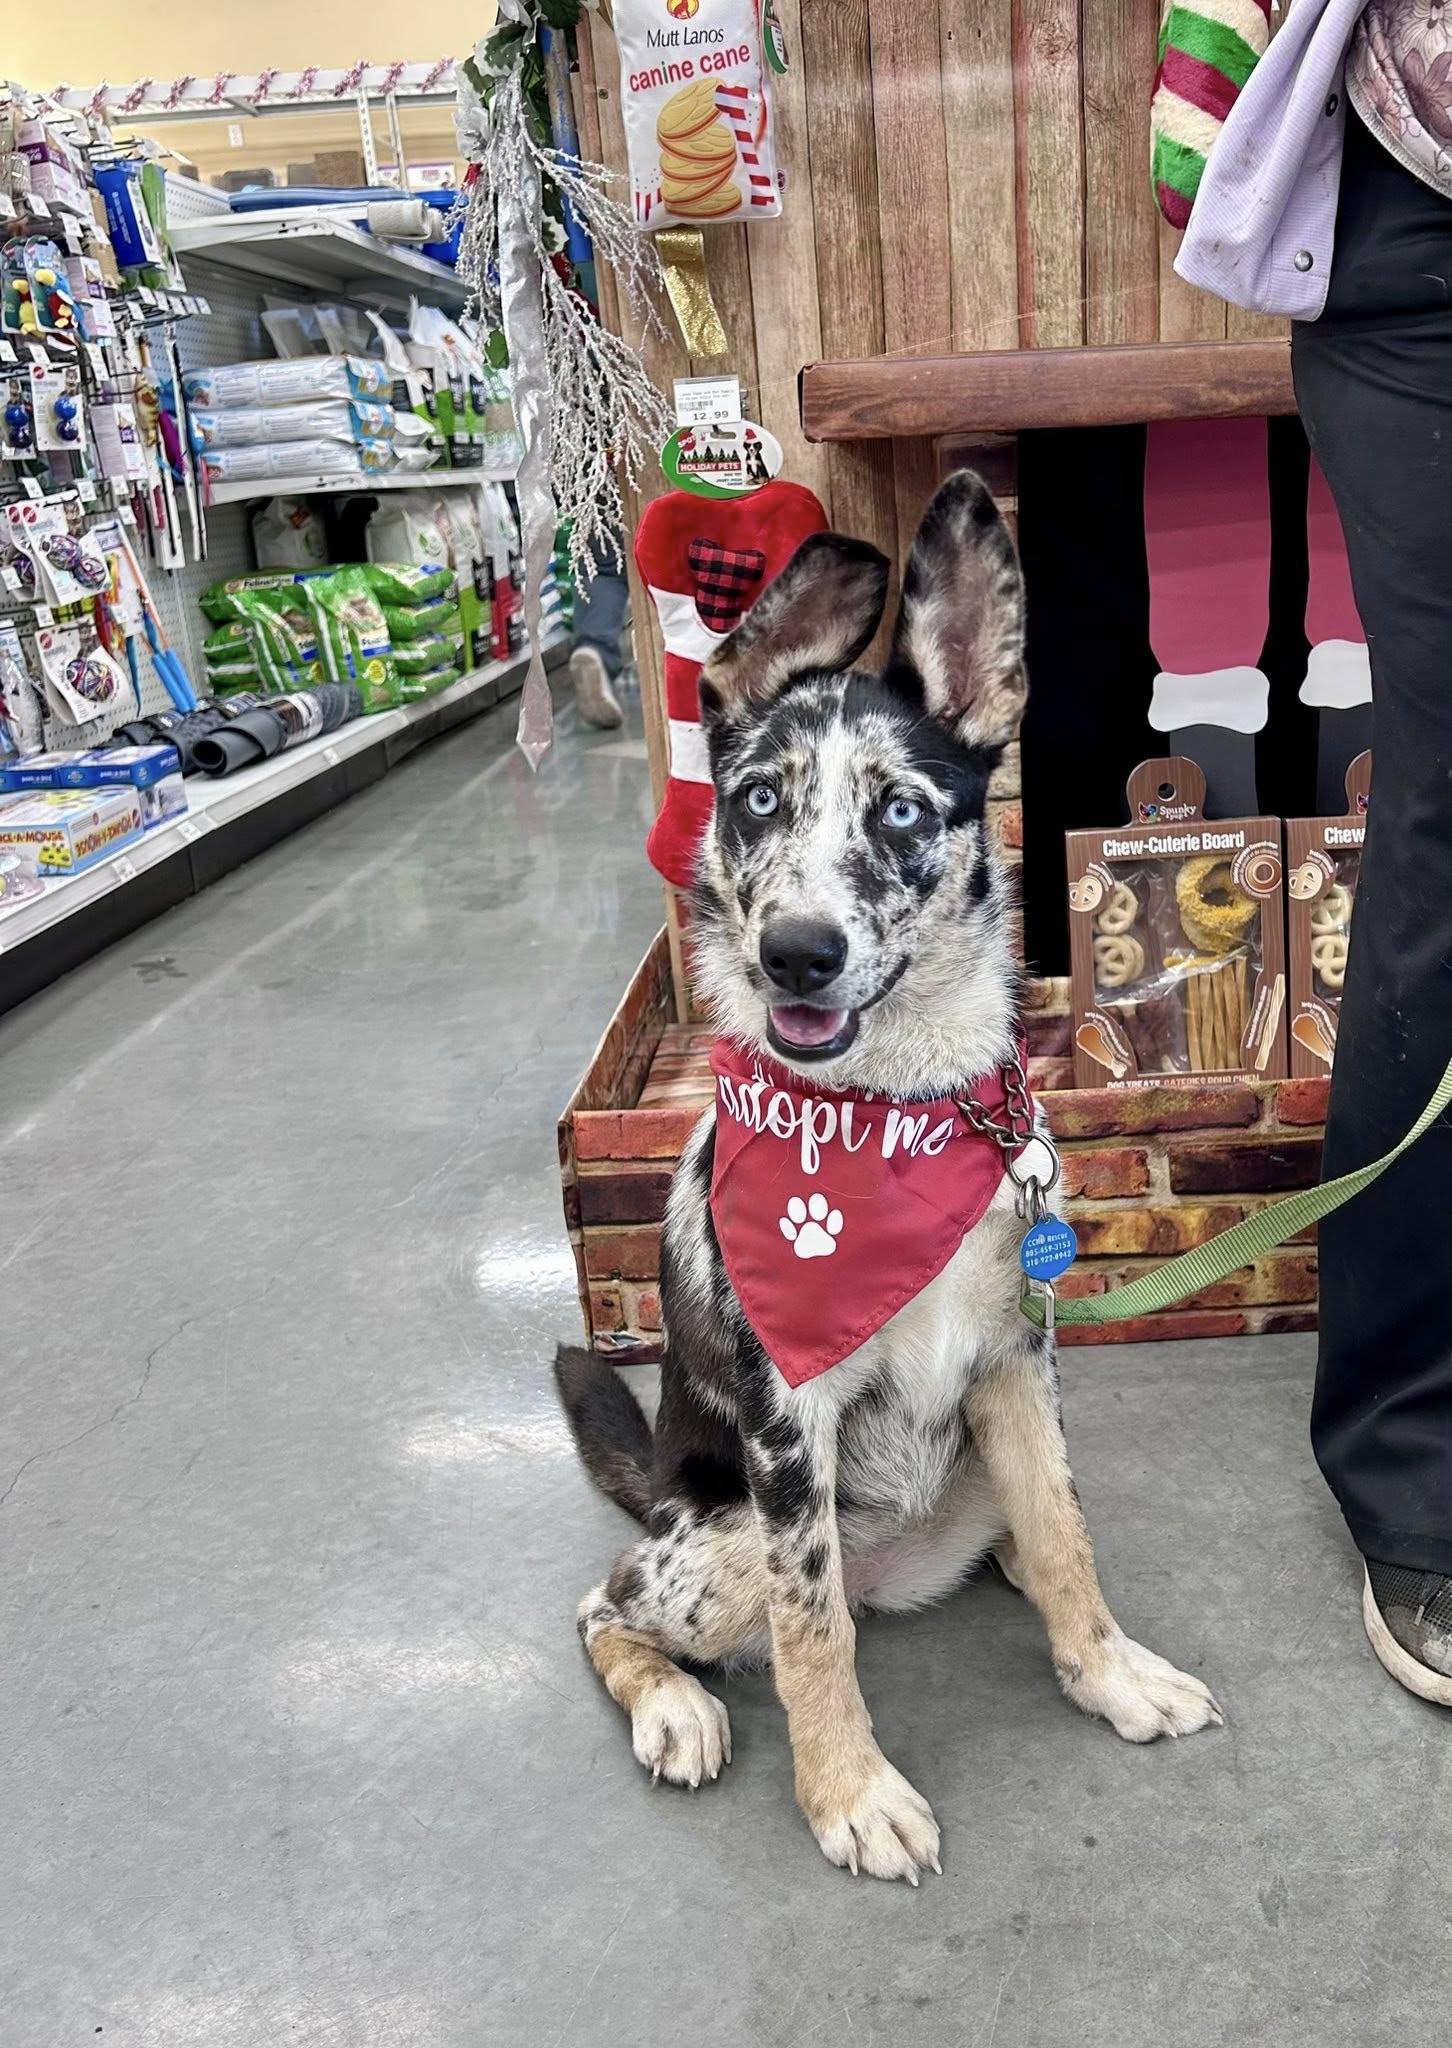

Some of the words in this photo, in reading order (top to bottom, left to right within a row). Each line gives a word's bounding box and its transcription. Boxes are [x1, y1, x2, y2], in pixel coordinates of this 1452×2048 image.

[646, 29, 679, 48] Mutt
[683, 27, 724, 45] Lanos
[629, 60, 695, 92] canine
[699, 44, 750, 74] cane
[694, 410, 729, 420] 12.99
[680, 463, 717, 471] HOLIDAY
[719, 462, 738, 470] PETS
[1159, 803, 1197, 819] Spunky
[1103, 835, 1201, 857] Chew-Cuterie
[1202, 830, 1245, 849] Board
[881, 1106, 956, 1159] me
